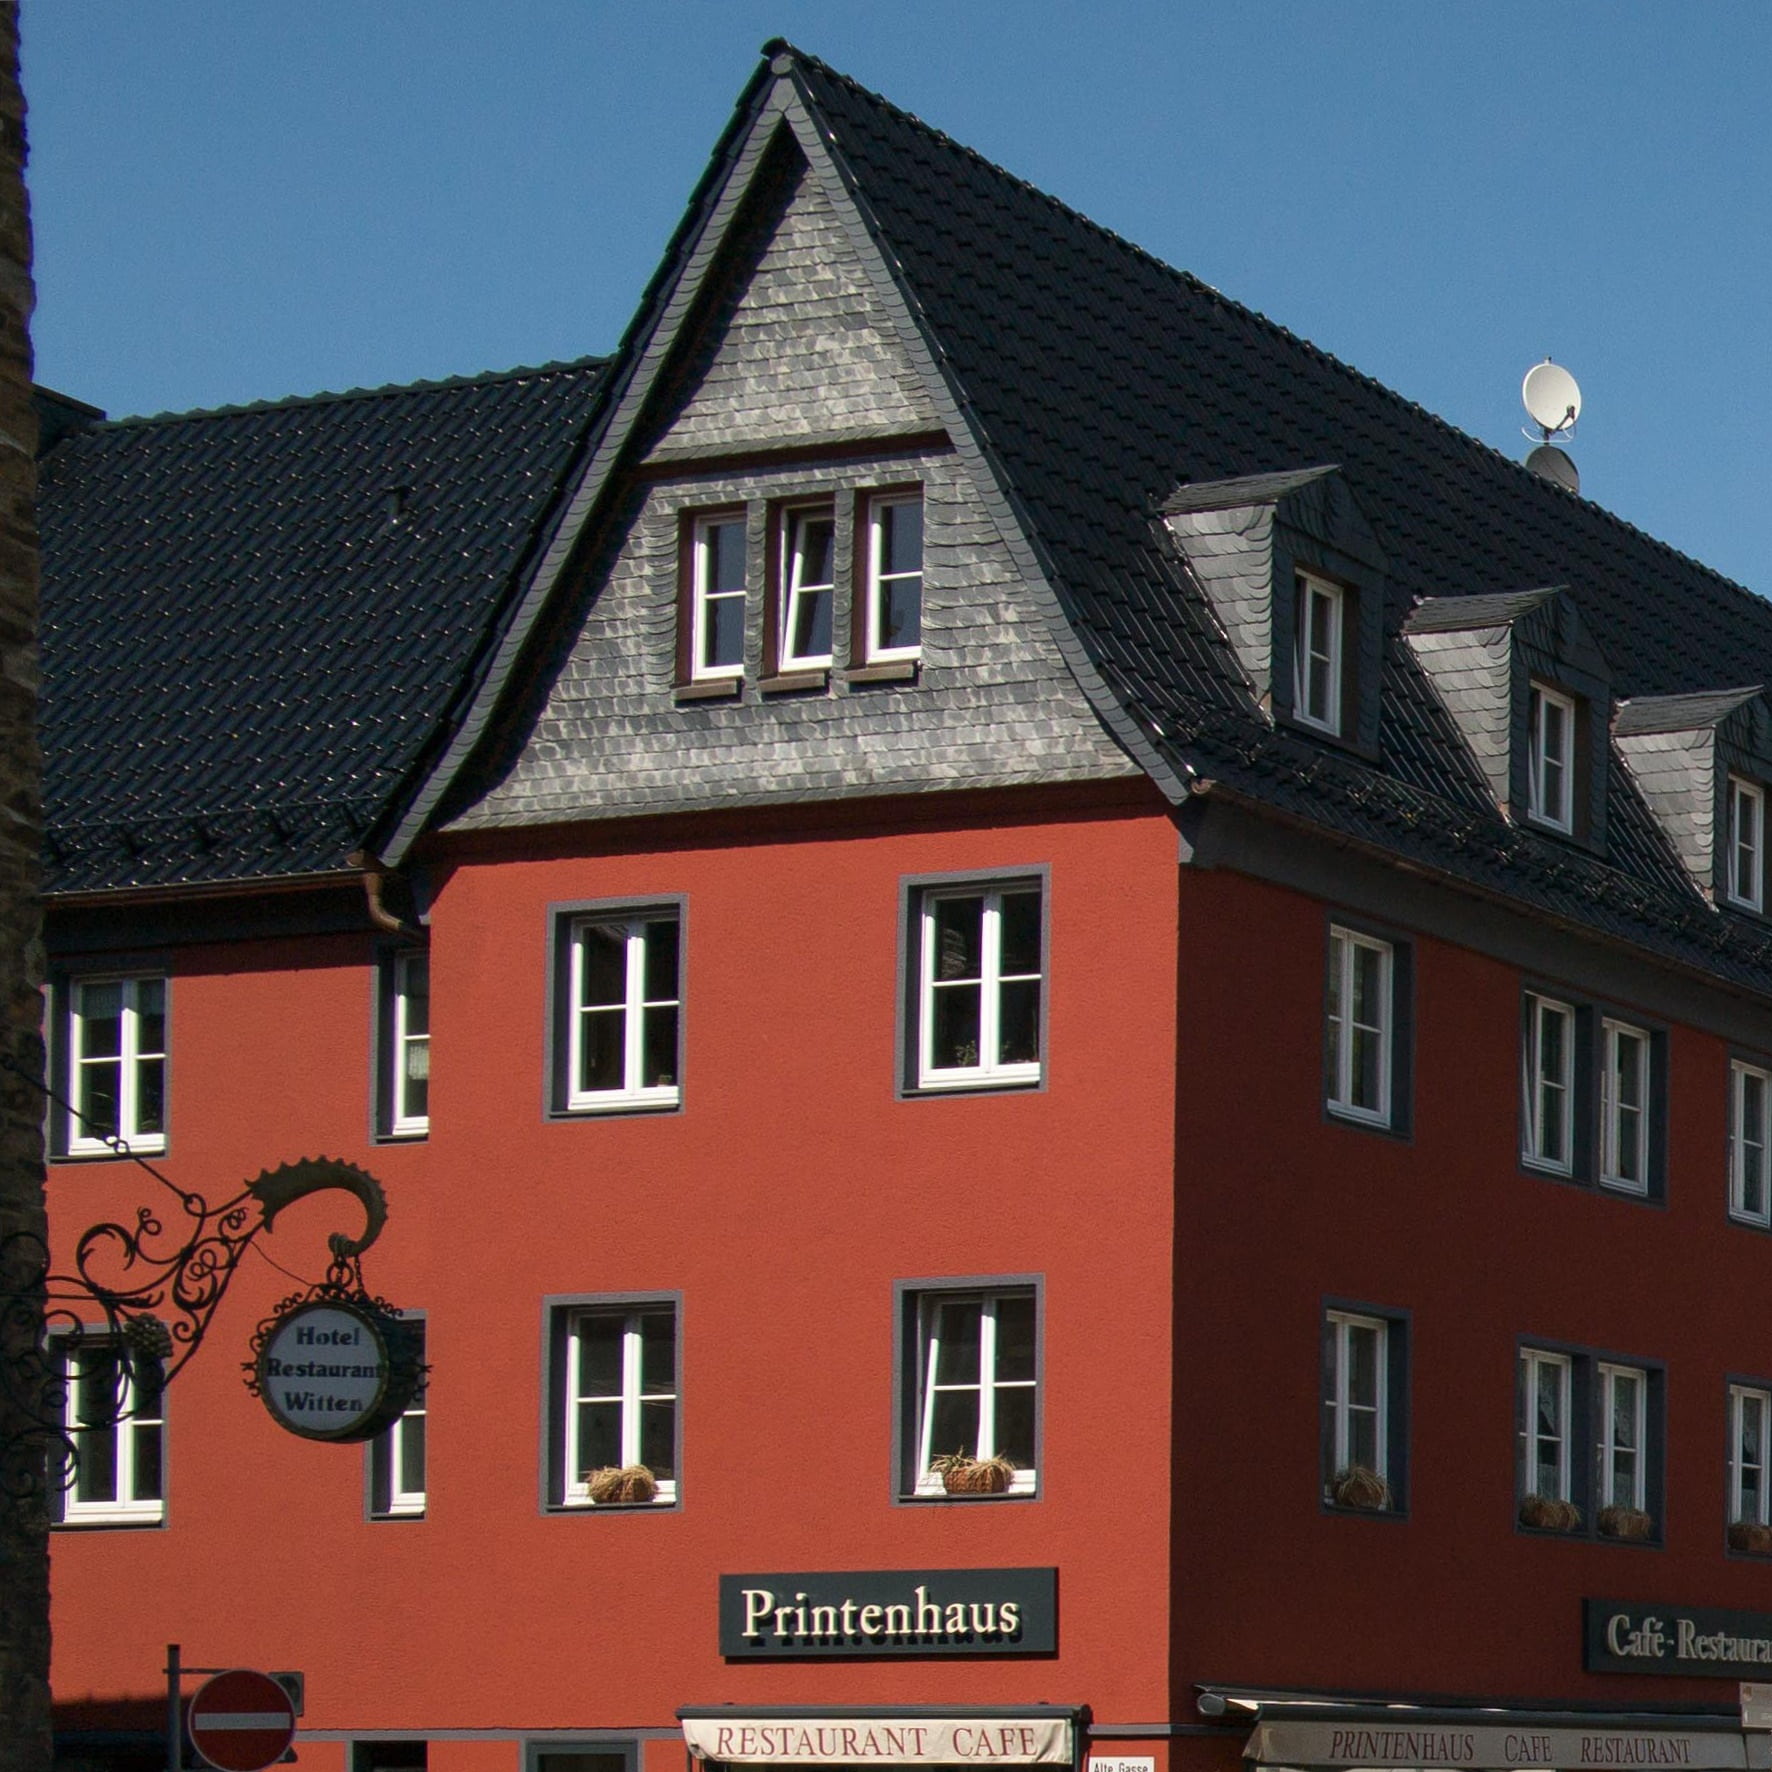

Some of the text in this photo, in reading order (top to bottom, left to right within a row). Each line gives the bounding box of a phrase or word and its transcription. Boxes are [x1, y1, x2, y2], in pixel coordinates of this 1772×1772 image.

[296, 1326, 360, 1346] Hotel
[285, 1391, 363, 1412] Witten
[741, 1585, 1022, 1637] Printenhaus
[716, 1727, 1038, 1757] RESTAURANT CAFE
[1329, 1730, 1692, 1765] PRINTENHAUS CAFE RESTAURANT
